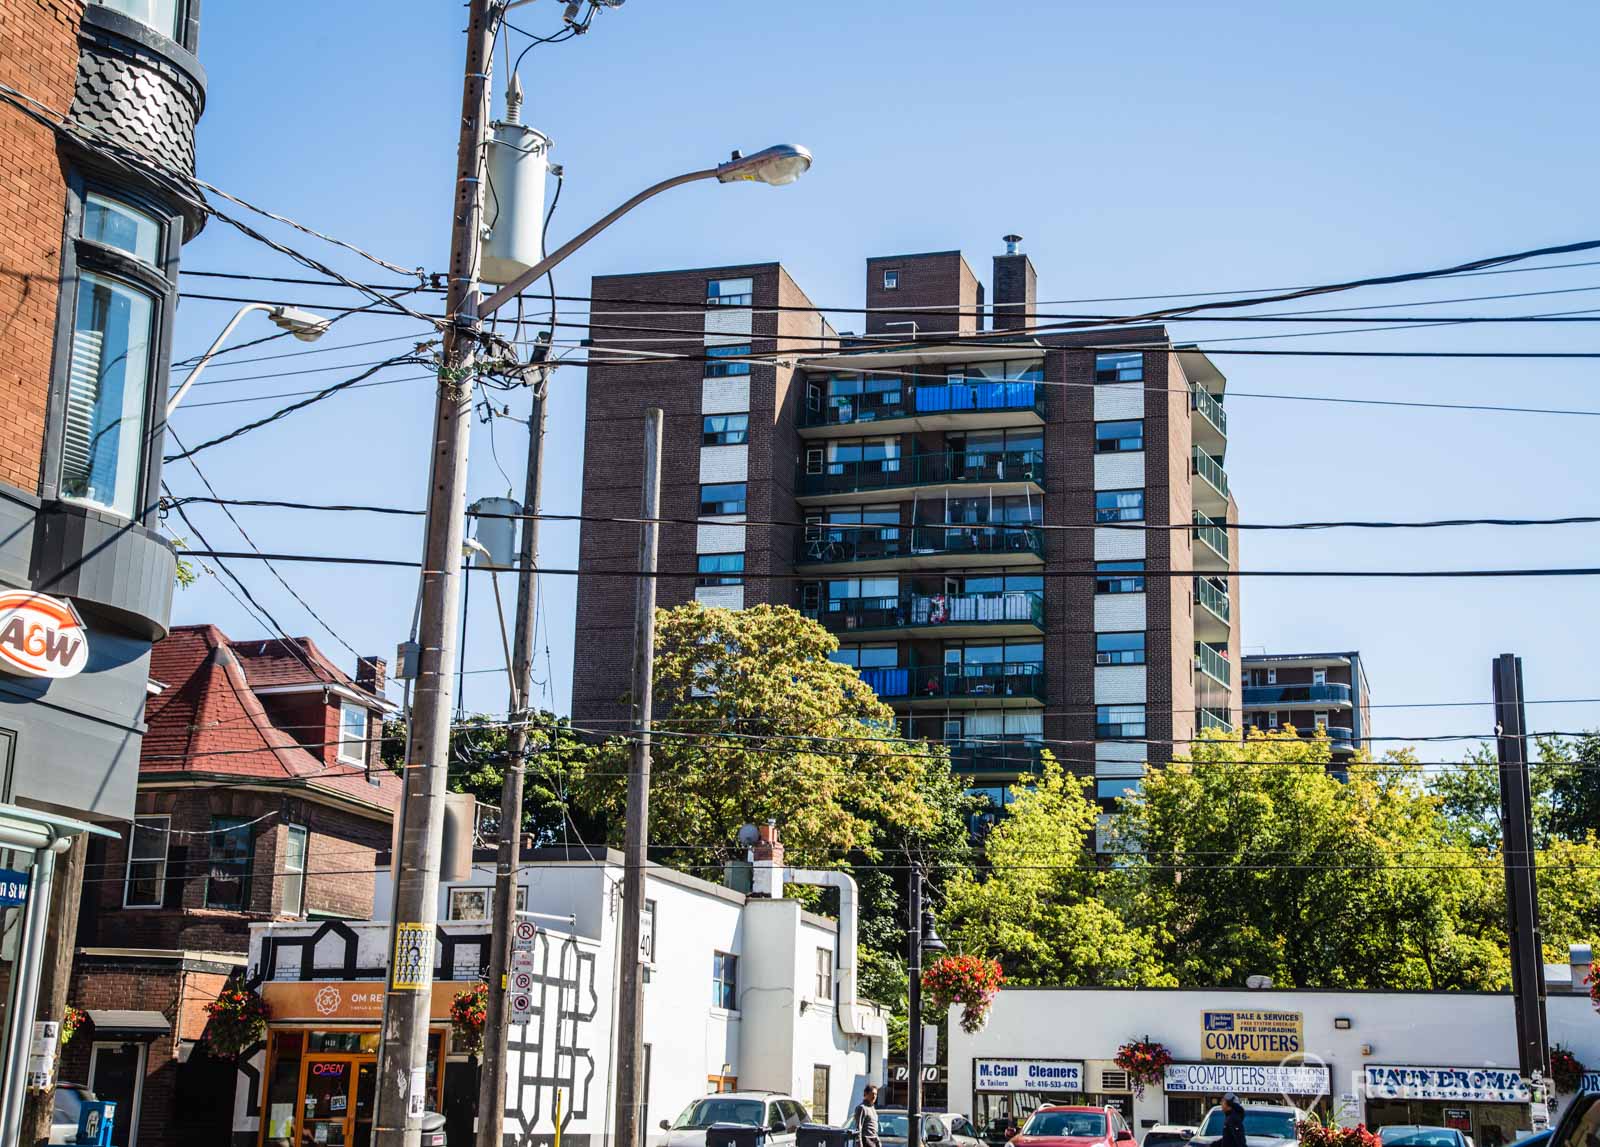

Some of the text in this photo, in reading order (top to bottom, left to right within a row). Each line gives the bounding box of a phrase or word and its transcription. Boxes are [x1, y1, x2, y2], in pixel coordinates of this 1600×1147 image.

[0, 615, 81, 667] A&W
[9, 881, 17, 898] St
[19, 883, 27, 899] W
[640, 934, 651, 957] 40
[351, 993, 385, 1003] OM RES
[1264, 1013, 1299, 1021] SERVICES
[1205, 1032, 1299, 1052] COMPUTERS
[312, 1063, 345, 1075] OPEN
[896, 1067, 937, 1081] PAIO
[1028, 1065, 1078, 1079] Cleaners
[1187, 1065, 1265, 1086] COMPUTERS
[987, 1079, 1009, 1087] Tailors
[1024, 1080, 1036, 1088] Tel:
